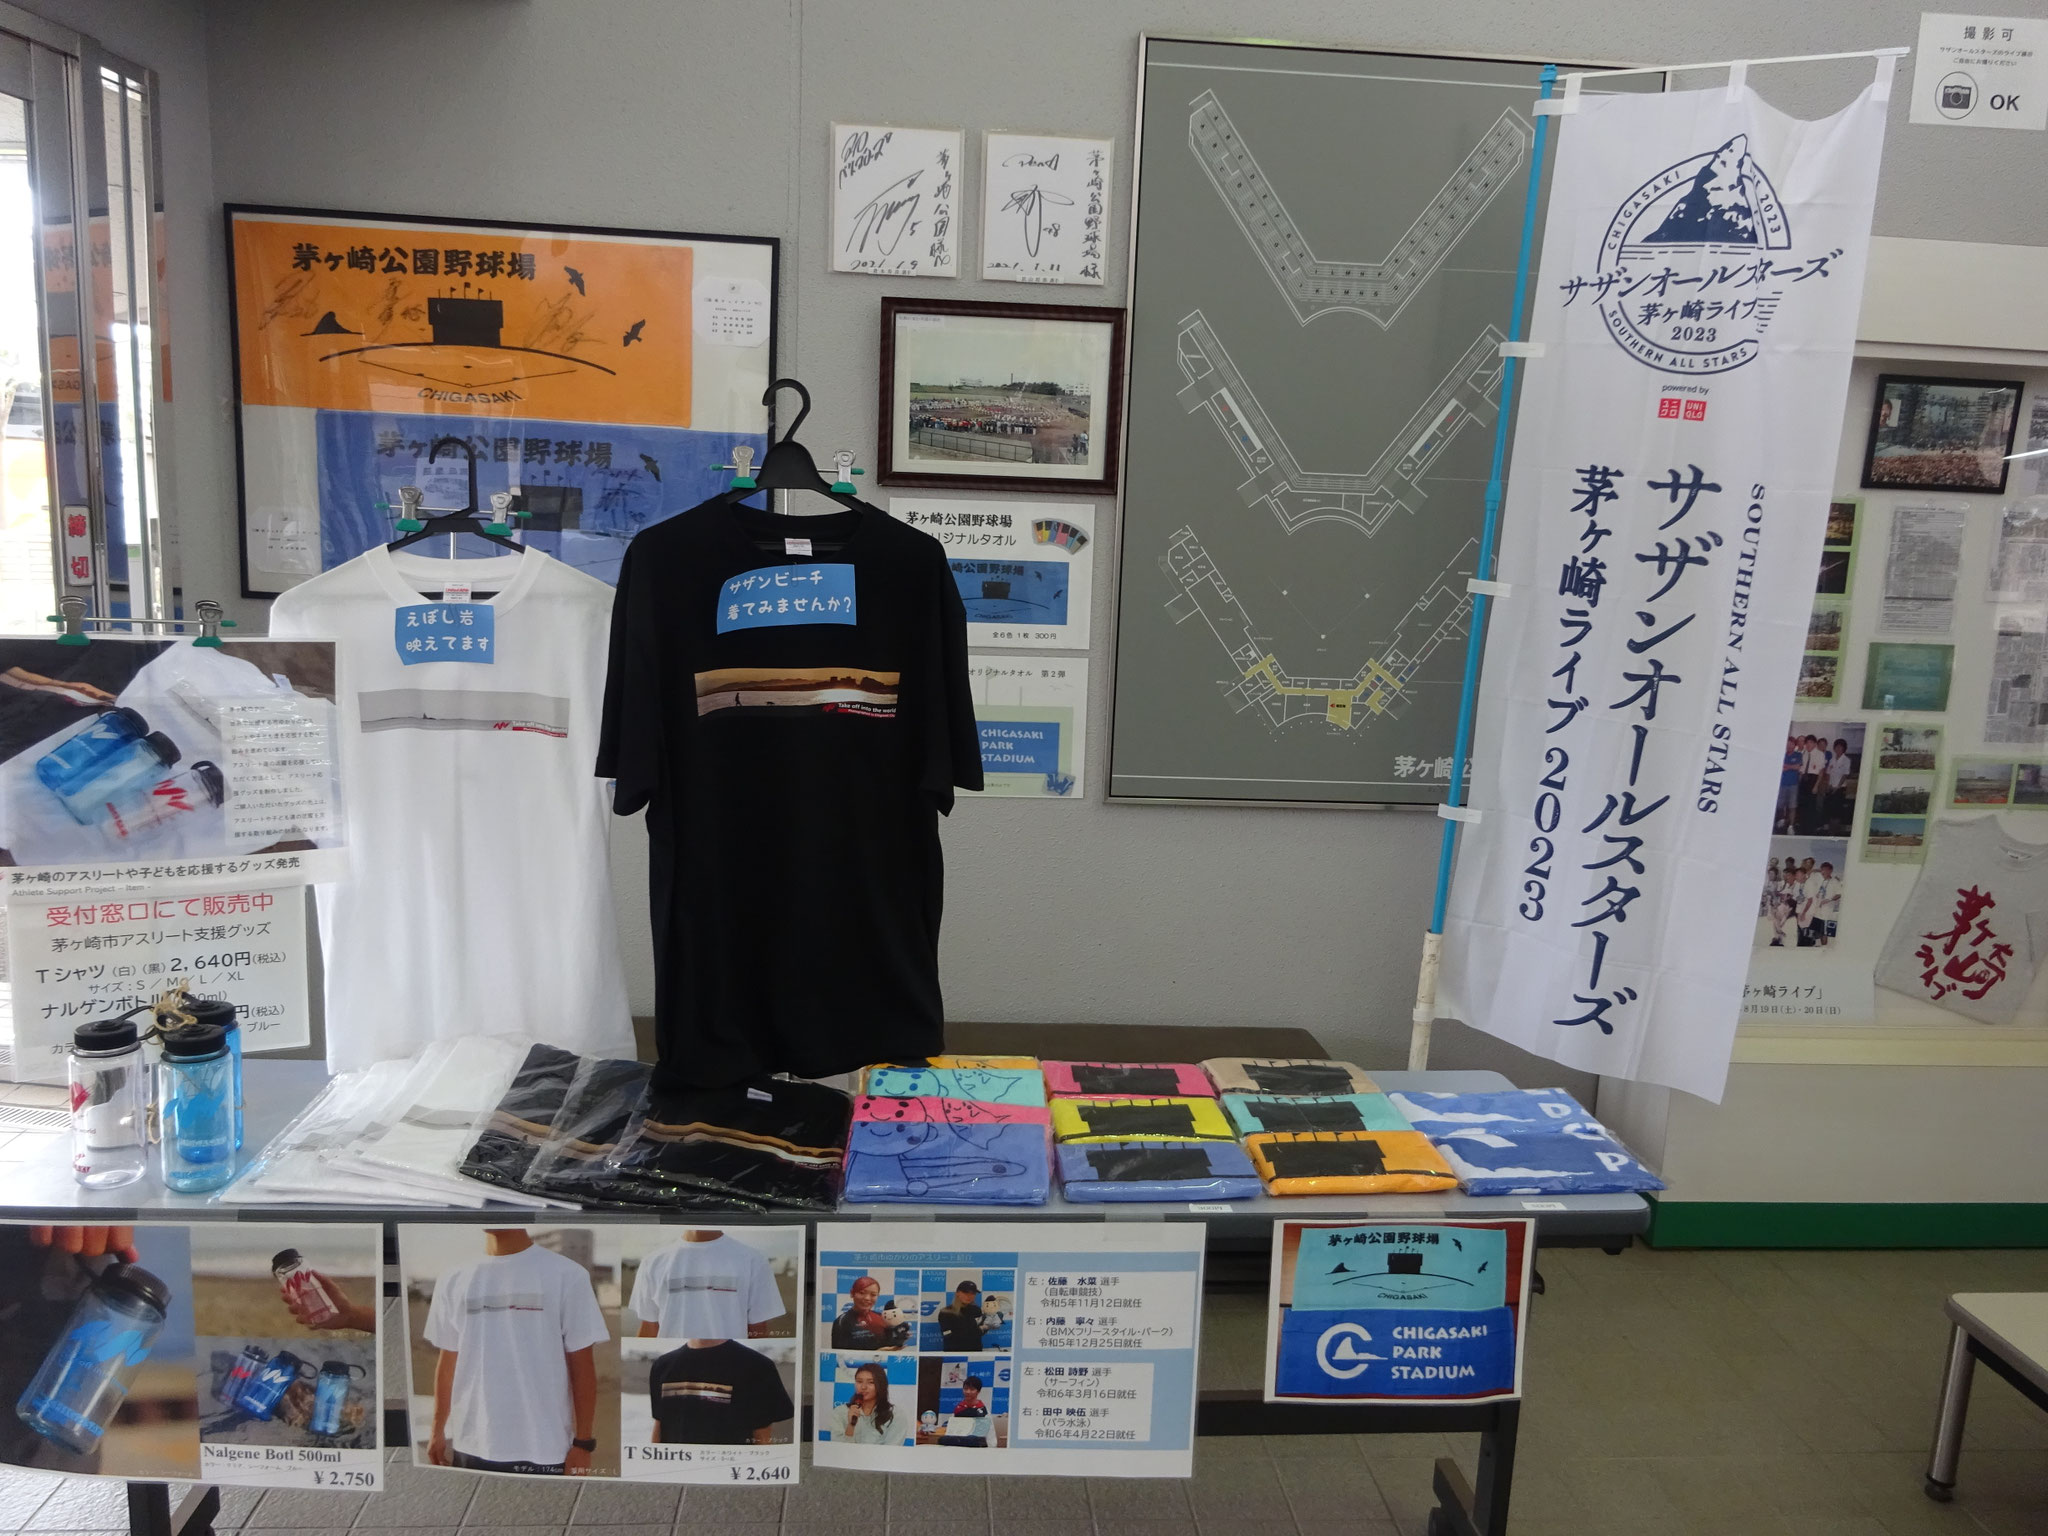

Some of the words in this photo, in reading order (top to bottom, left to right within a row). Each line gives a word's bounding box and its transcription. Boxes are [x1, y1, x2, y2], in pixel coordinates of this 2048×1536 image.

[1964, 26, 2014, 41] 撮影可
[1990, 94, 2020, 111] OK
[1608, 170, 1681, 251] CHIGASAKI
[292, 243, 537, 282] 茅ヶ崎公園野球場
[1560, 248, 1844, 308] サザンオールスターズ
[1608, 309, 1663, 363] SOUTHERN
[1669, 356, 1695, 368] ALL
[1703, 347, 1748, 368] STARS
[1671, 326, 1717, 342] 2023
[417, 386, 522, 404] CHIGASAKI
[1662, 385, 1697, 393] powered
[1700, 386, 1710, 396] by
[905, 510, 1013, 528] 茅ヶ崎公園野球場
[925, 532, 1016, 546] リジナルタオル
[1726, 482, 1765, 650] SOUTHERN
[729, 570, 823, 594] サザンビーチ
[406, 609, 474, 627] えぼし岩
[406, 636, 489, 652] 映えてます
[1718, 656, 1741, 714] ALL
[981, 729, 1044, 740] CHIGASAKI
[982, 741, 1014, 750] PARK
[1553, 463, 1723, 1036] サザンオールスターズ
[981, 753, 1035, 763] STADIUM
[1696, 722, 1732, 815] STARS
[12, 857, 301, 884] 茅ヶ崎のアスリートや子どもを応援するグッズ発売
[47, 886, 82, 896] Support
[85, 885, 115, 894] Project
[47, 892, 273, 927] 受付窓口にて販売中
[51, 922, 271, 952] 茅ヶ崎市アスリート支援グッズ
[247, 1022, 281, 1032] ブルー
[1327, 1231, 1440, 1246] 茅ヶ崎公園野球場
[1040, 1298, 1142, 1308] 令和5年11月12日就任
[1377, 1292, 1428, 1301] CHIGASAKI
[1392, 1325, 1487, 1340] CHIGASAKI
[1039, 1338, 1142, 1348] 令和5年12月25日就任
[1393, 1346, 1443, 1359] PARK
[1391, 1364, 1475, 1380] STADIUM
[1036, 1389, 1137, 1399] 令和6年3月16日就任
[1035, 1429, 1136, 1440] 令和6年4月22日就任
[204, 1445, 261, 1460] Nalgene
[266, 1448, 294, 1461] Botl
[298, 1450, 342, 1463] 500ml
[624, 1446, 637, 1459] T
[642, 1446, 692, 1461] Shirts
